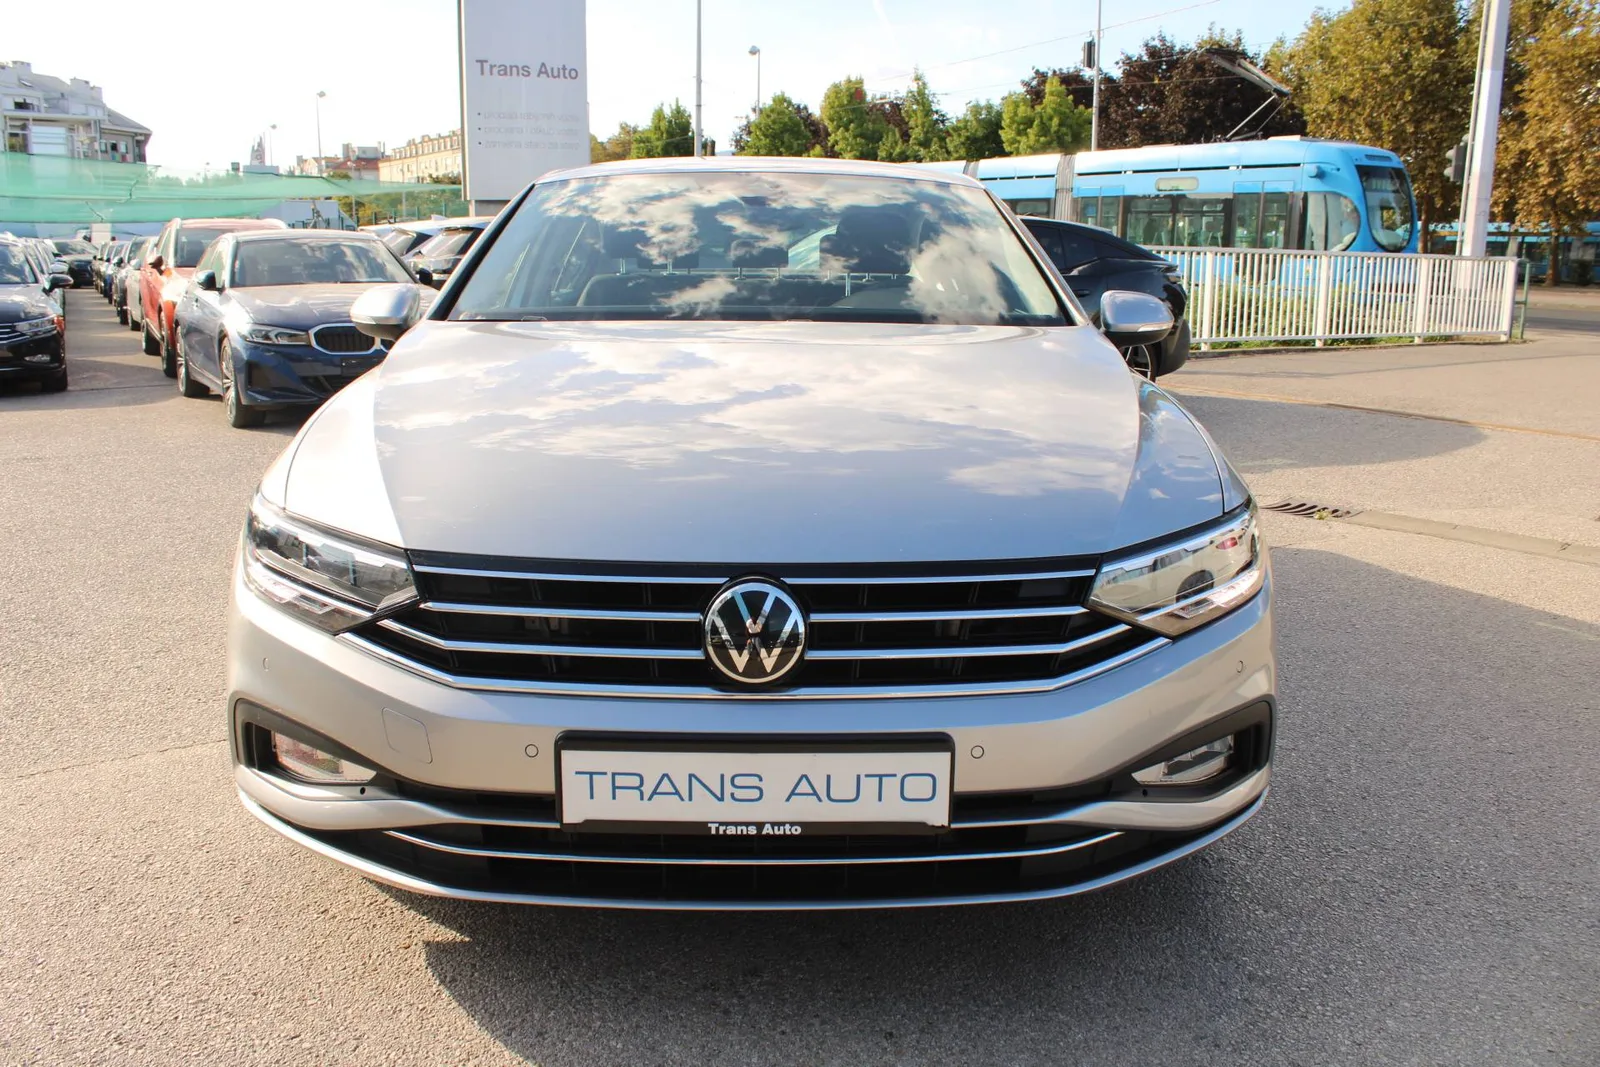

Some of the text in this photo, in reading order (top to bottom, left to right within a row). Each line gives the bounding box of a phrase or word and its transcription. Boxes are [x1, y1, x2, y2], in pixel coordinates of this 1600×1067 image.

[475, 59, 579, 80] Trans Auto
[707, 584, 803, 679] VW
[575, 771, 938, 803] TRANS AUTO
[707, 823, 802, 835] Trans Auto
